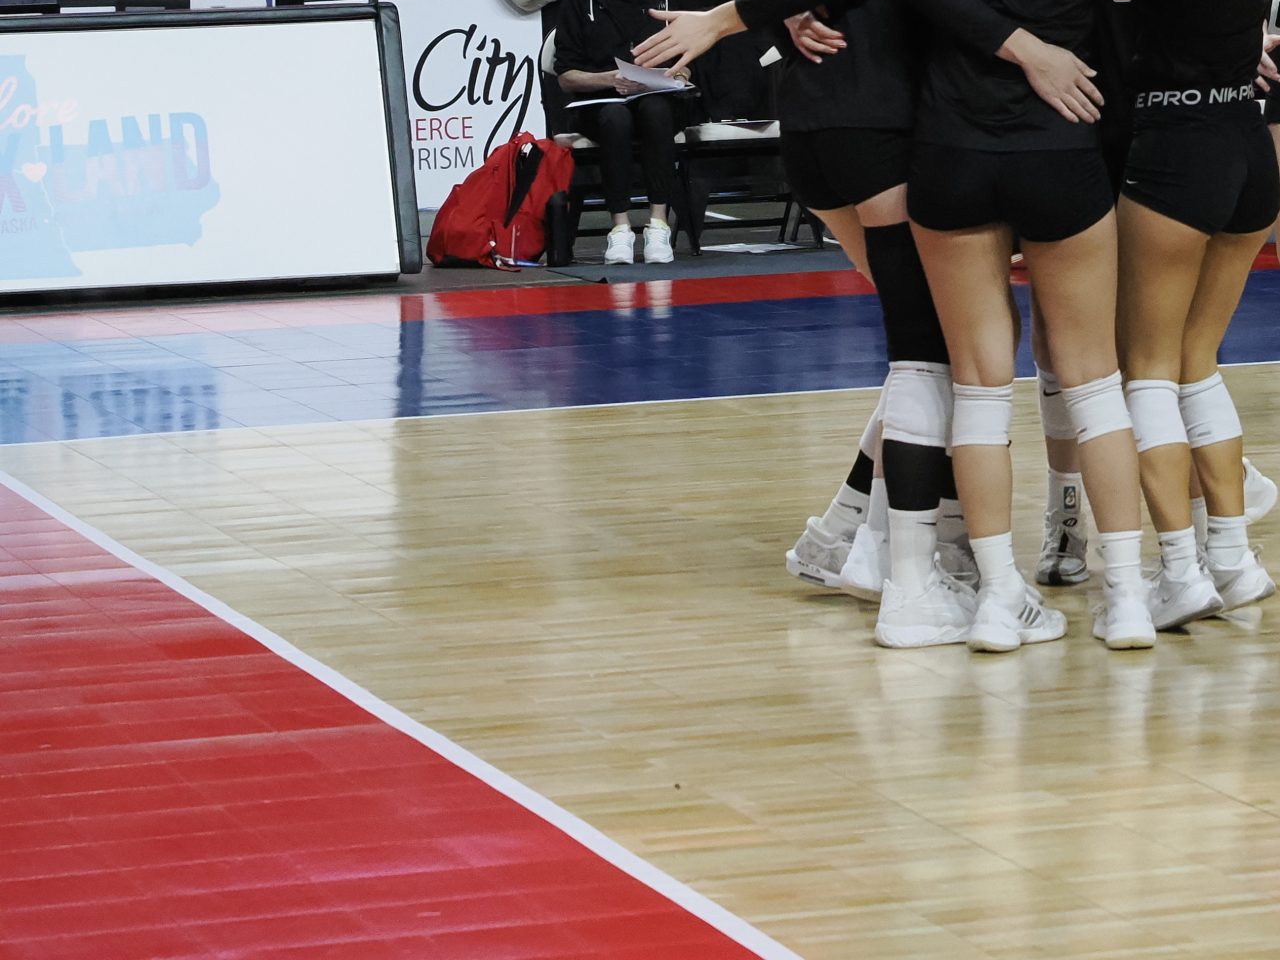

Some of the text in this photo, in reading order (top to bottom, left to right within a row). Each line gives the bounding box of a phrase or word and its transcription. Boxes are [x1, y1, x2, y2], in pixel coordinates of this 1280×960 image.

[0, 75, 78, 131] lore
[413, 23, 534, 163] City
[1147, 89, 1202, 107] PRO
[415, 116, 474, 141] ERCE
[418, 146, 475, 170] RISM
[1, 217, 39, 234] ASKA
